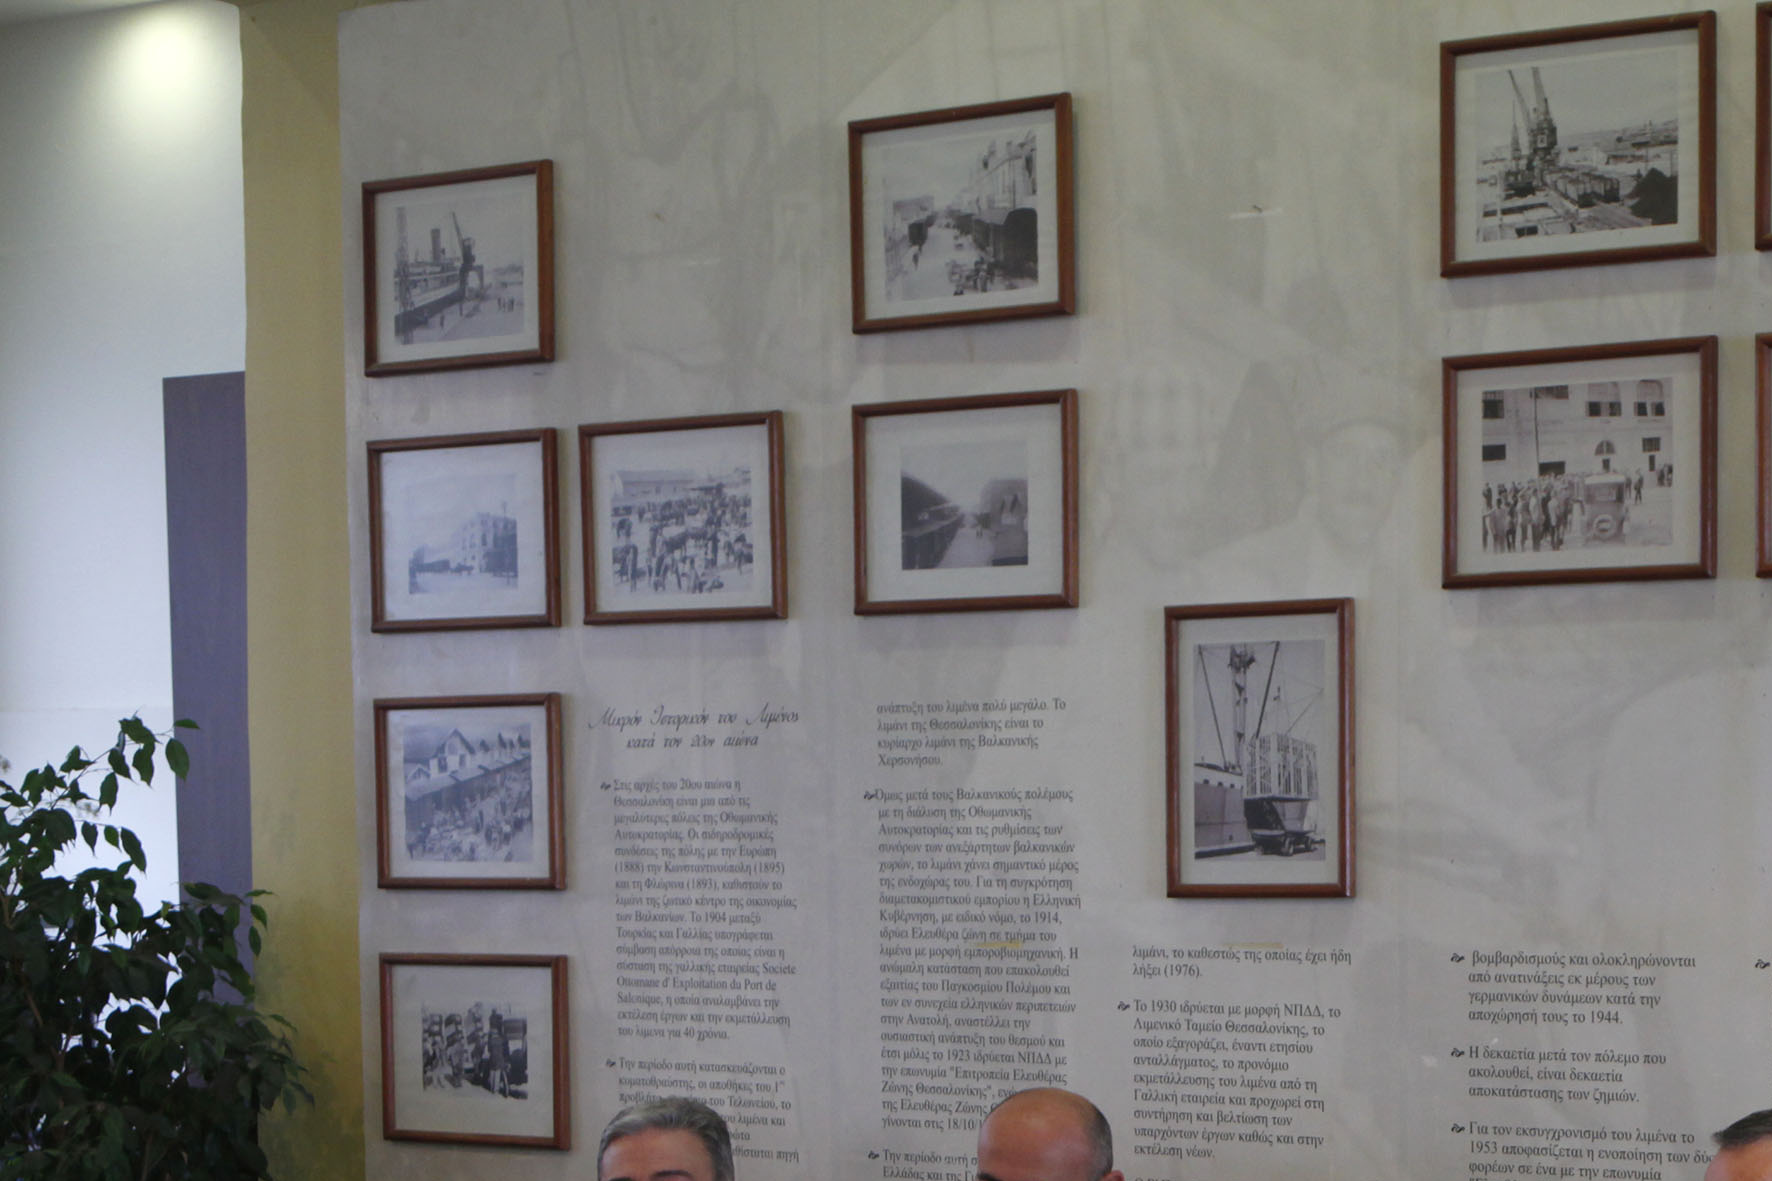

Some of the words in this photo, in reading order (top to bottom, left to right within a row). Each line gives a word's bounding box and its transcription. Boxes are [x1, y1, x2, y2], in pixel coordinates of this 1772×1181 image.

[1171, 950, 1185, 959] το
[1186, 947, 1240, 964] καθεστώς
[1243, 951, 1262, 964] της
[1264, 948, 1303, 965] οποίας
[1304, 949, 1327, 965] έχει
[1329, 949, 1352, 966] ήδη
[1471, 951, 1566, 969] βομβαρδισμούς
[1568, 957, 1589, 966] και
[1591, 954, 1696, 971] ολοκληρώνονται
[1132, 963, 1161, 980] λήξει
[1467, 971, 1491, 984] από
[1493, 972, 1565, 988] ανατινάξεις
[1566, 976, 1582, 985] εκ
[1584, 973, 1629, 989] μέρους
[1632, 977, 1656, 986] των
[1132, 999, 1148, 1012] Το
[1150, 1000, 1177, 1013] 1930
[1179, 1001, 1225, 1017] ιδρύεται
[1227, 1005, 1241, 1018] με
[1243, 1003, 1281, 1019] μορφή
[1327, 1008, 1341, 1017] το
[1467, 991, 1539, 1007] γερμανικών
[1540, 991, 1603, 1008] δυνάμεων
[1605, 992, 1636, 1005] κατά
[1638, 996, 1661, 1009] την
[1467, 1009, 1538, 1026] αποχώρησή
[1541, 1013, 1569, 1026] τους
[1571, 1014, 1586, 1023] το
[1590, 1010, 1623, 1024] 1944.
[1133, 1018, 1182, 1034] Λιμενικό
[1183, 1019, 1222, 1036] Ταμείο
[1311, 1026, 1325, 1035] το
[1468, 1047, 1479, 1059] Η
[1482, 1047, 1535, 1061] δεκαετία
[1537, 1049, 1567, 1065] μετά
[1569, 1053, 1591, 1063] τον
[1593, 1050, 1640, 1068] πόλεμο
[1642, 1055, 1667, 1065] που
[1467, 1066, 1533, 1082] ακολουθεί,
[1536, 1068, 1566, 1081] είναι
[1568, 1069, 1623, 1083] δεκαετία
[1133, 1109, 1193, 1126] συντήρηση
[1195, 1113, 1214, 1123] και
[1215, 1110, 1268, 1128] βελτίωση
[1271, 1116, 1293, 1126] των
[1468, 1122, 1489, 1135] Για
[1491, 1127, 1512, 1136] τον
[1514, 1128, 1607, 1144] εκσυγχρονισμό
[1610, 1132, 1632, 1141] του
[1634, 1129, 1677, 1146] λιμένα
[1680, 1135, 1695, 1144] το
[1133, 1143, 1183, 1160] εκτέλεση
